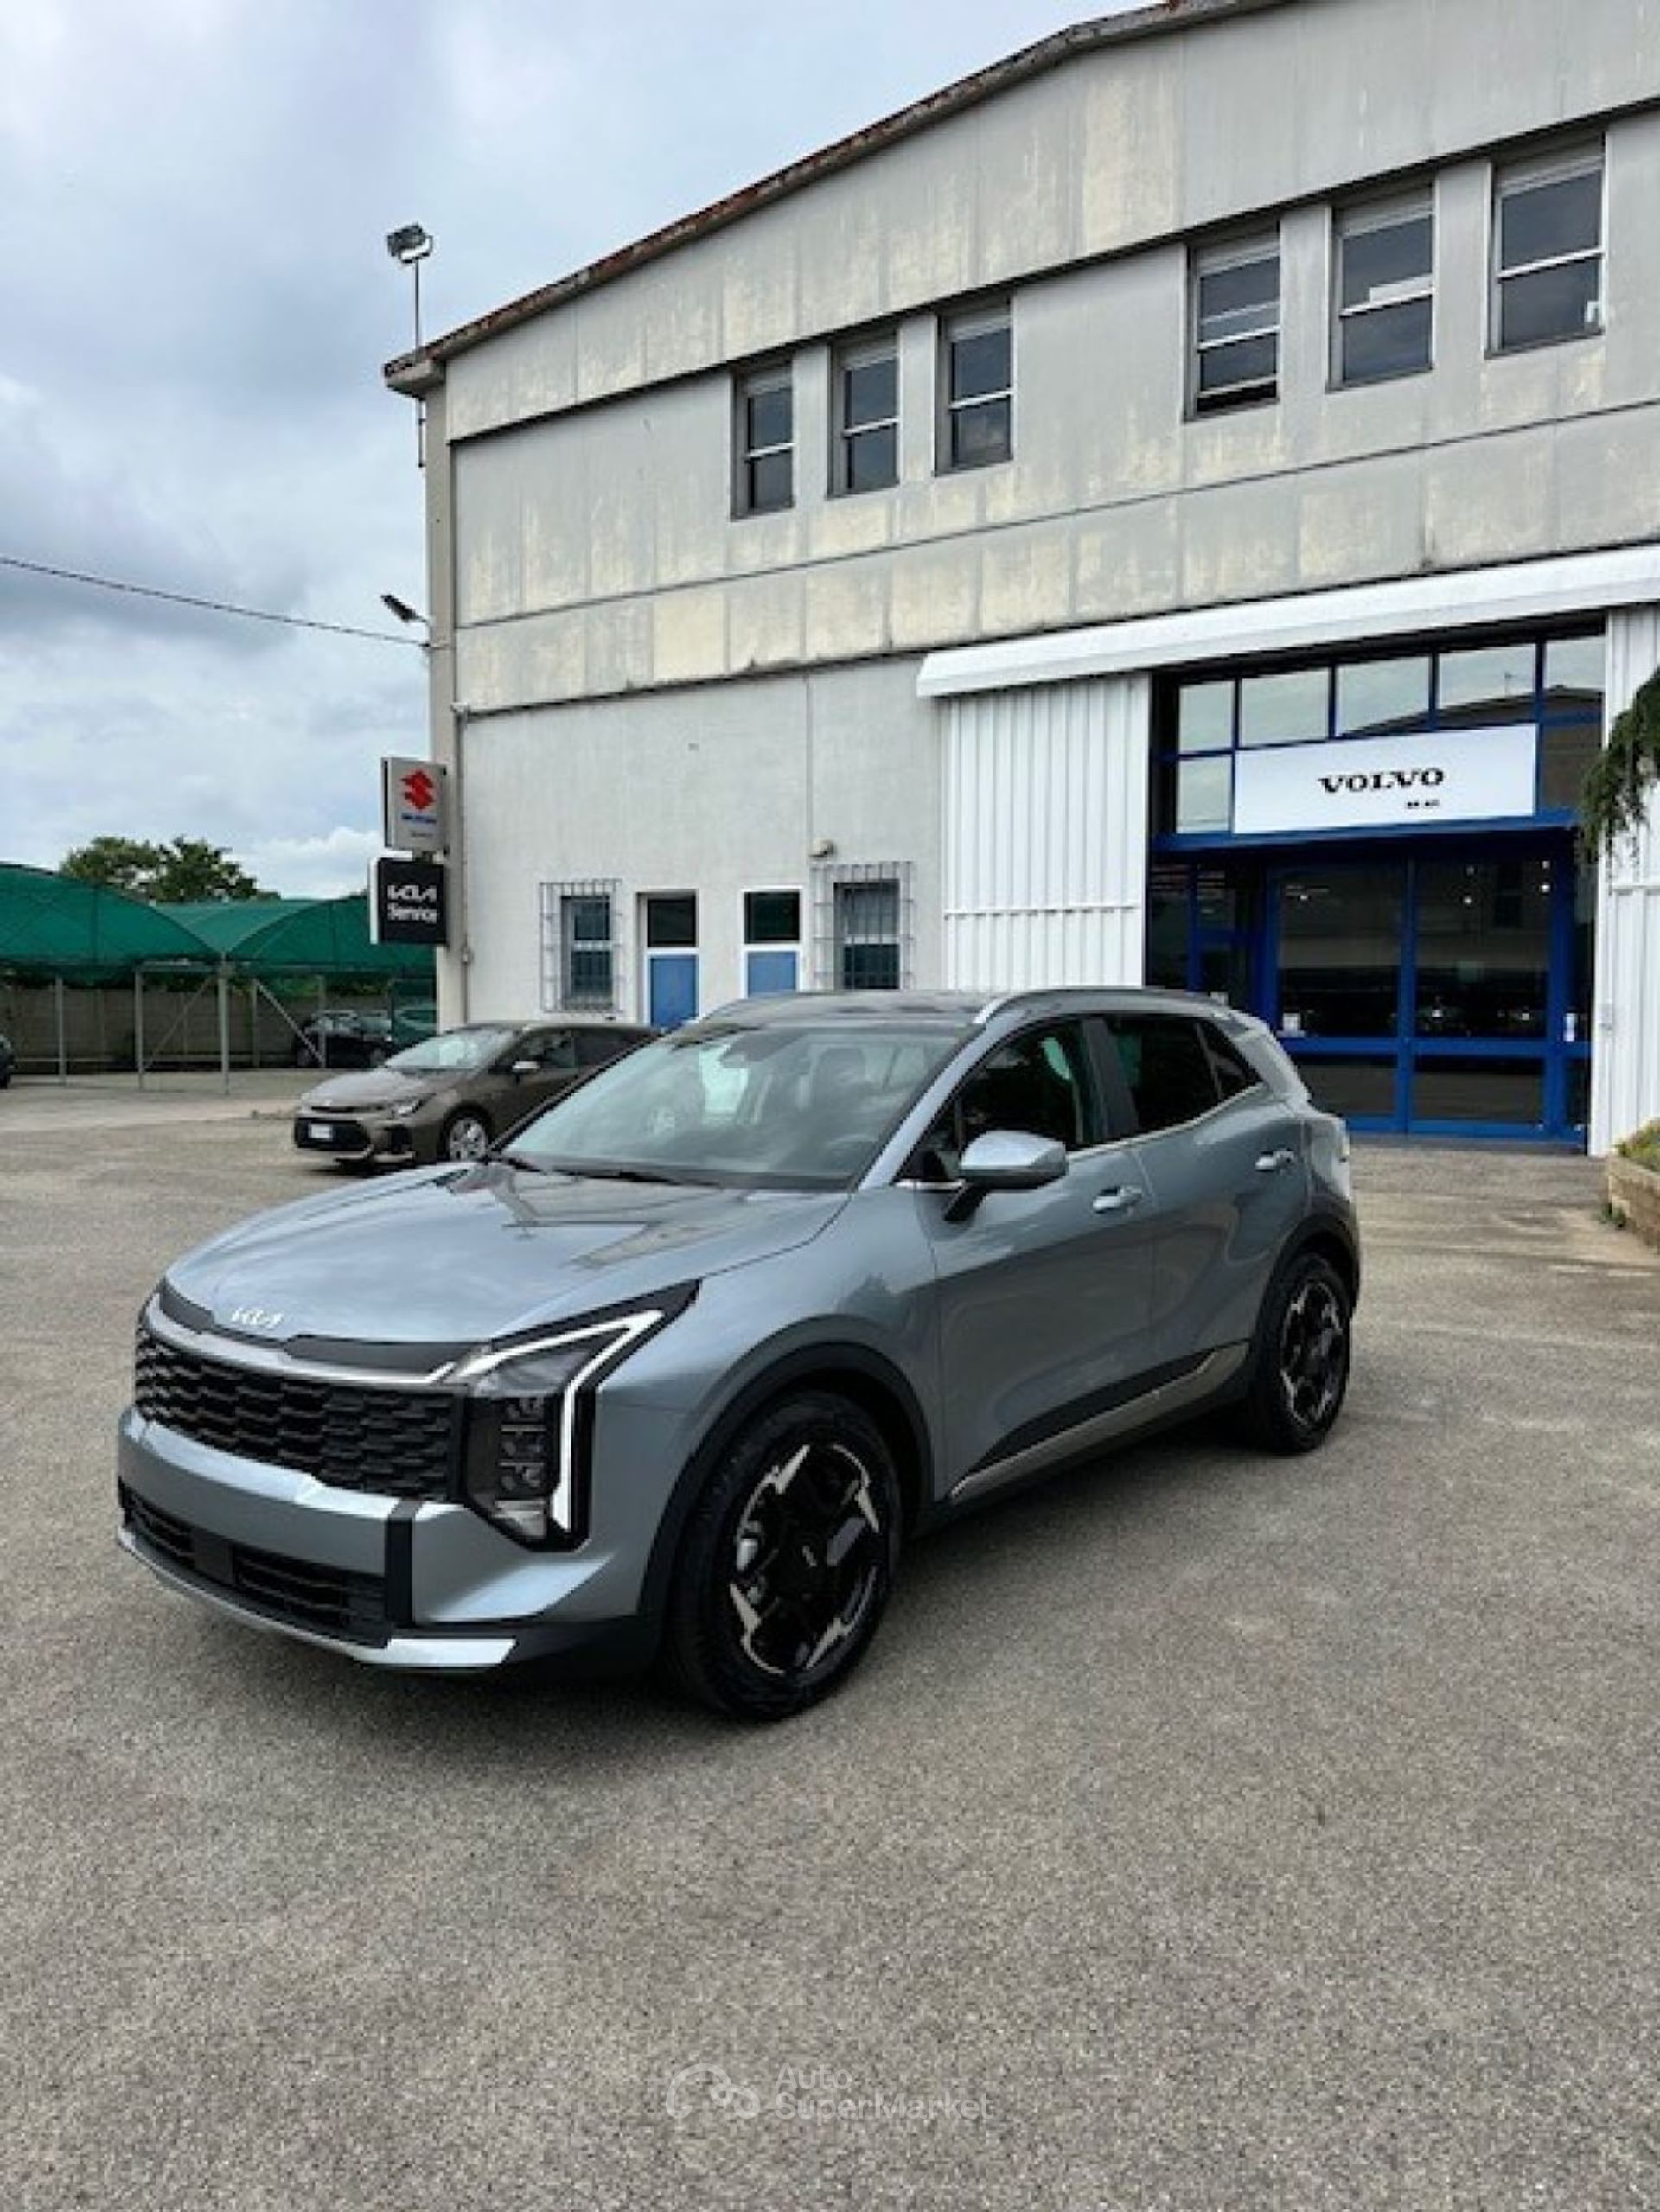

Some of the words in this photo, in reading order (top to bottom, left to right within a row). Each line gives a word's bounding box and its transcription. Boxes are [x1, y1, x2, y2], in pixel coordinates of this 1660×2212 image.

[1318, 768, 1444, 793] VOLVO
[386, 884, 437, 902] KIA
[231, 1307, 284, 1328] KIA
